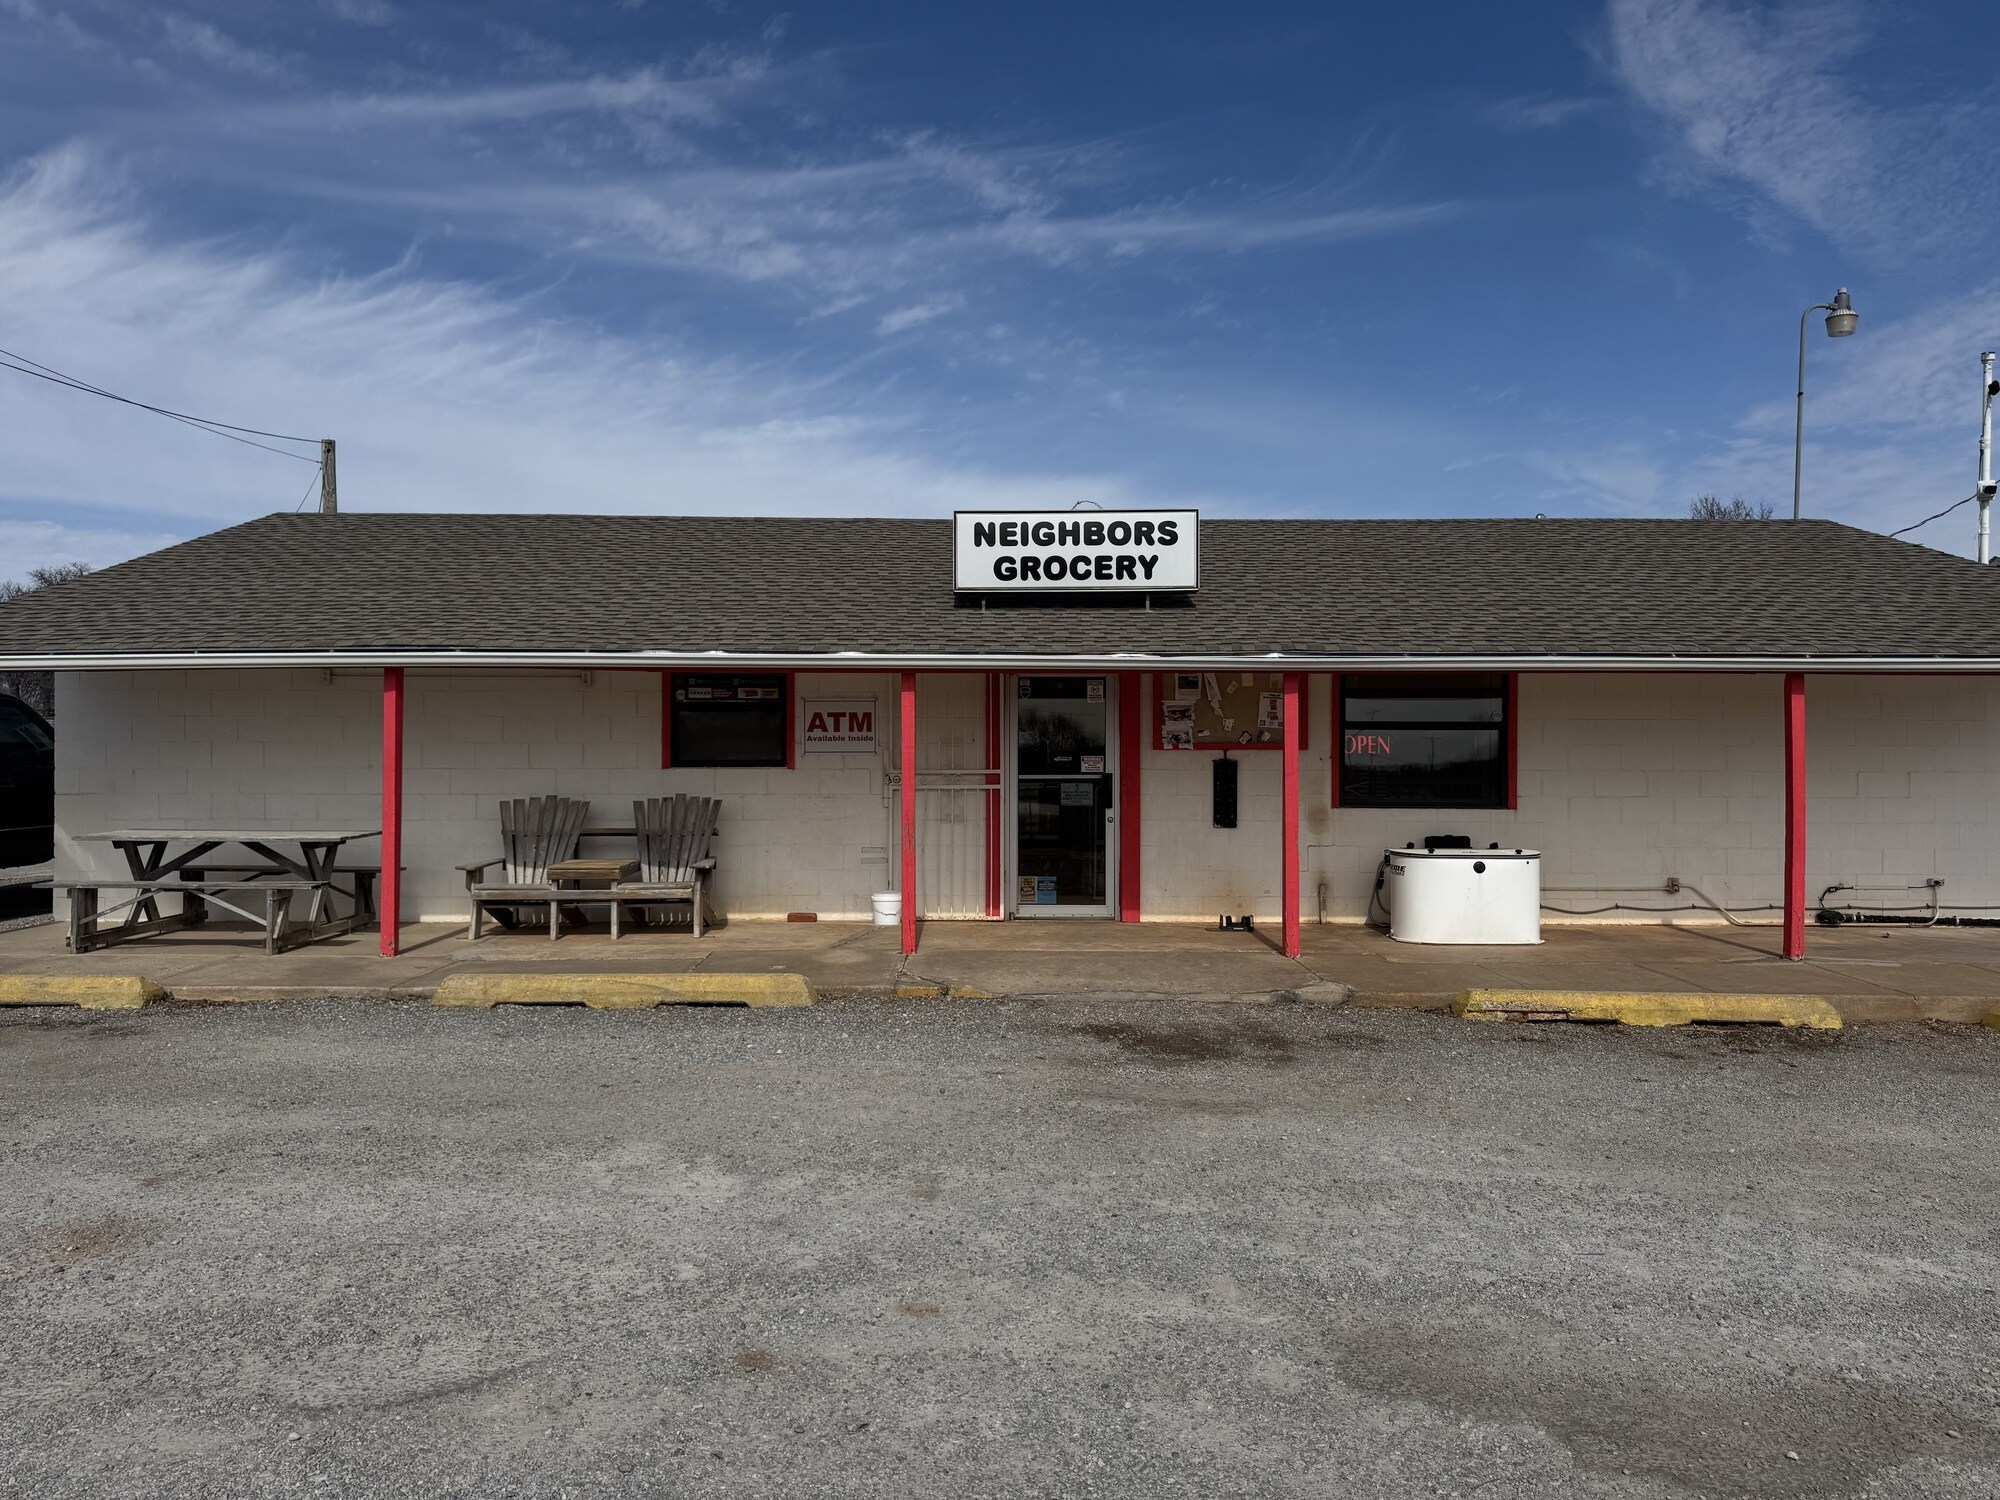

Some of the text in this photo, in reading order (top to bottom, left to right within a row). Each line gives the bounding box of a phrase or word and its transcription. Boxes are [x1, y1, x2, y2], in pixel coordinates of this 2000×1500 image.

[973, 520, 1179, 547] NEIGHBORS
[993, 554, 1159, 581] GROCERY
[806, 711, 873, 733] ATM
[806, 734, 874, 742] Available Inside
[1344, 735, 1391, 754] OPEN
